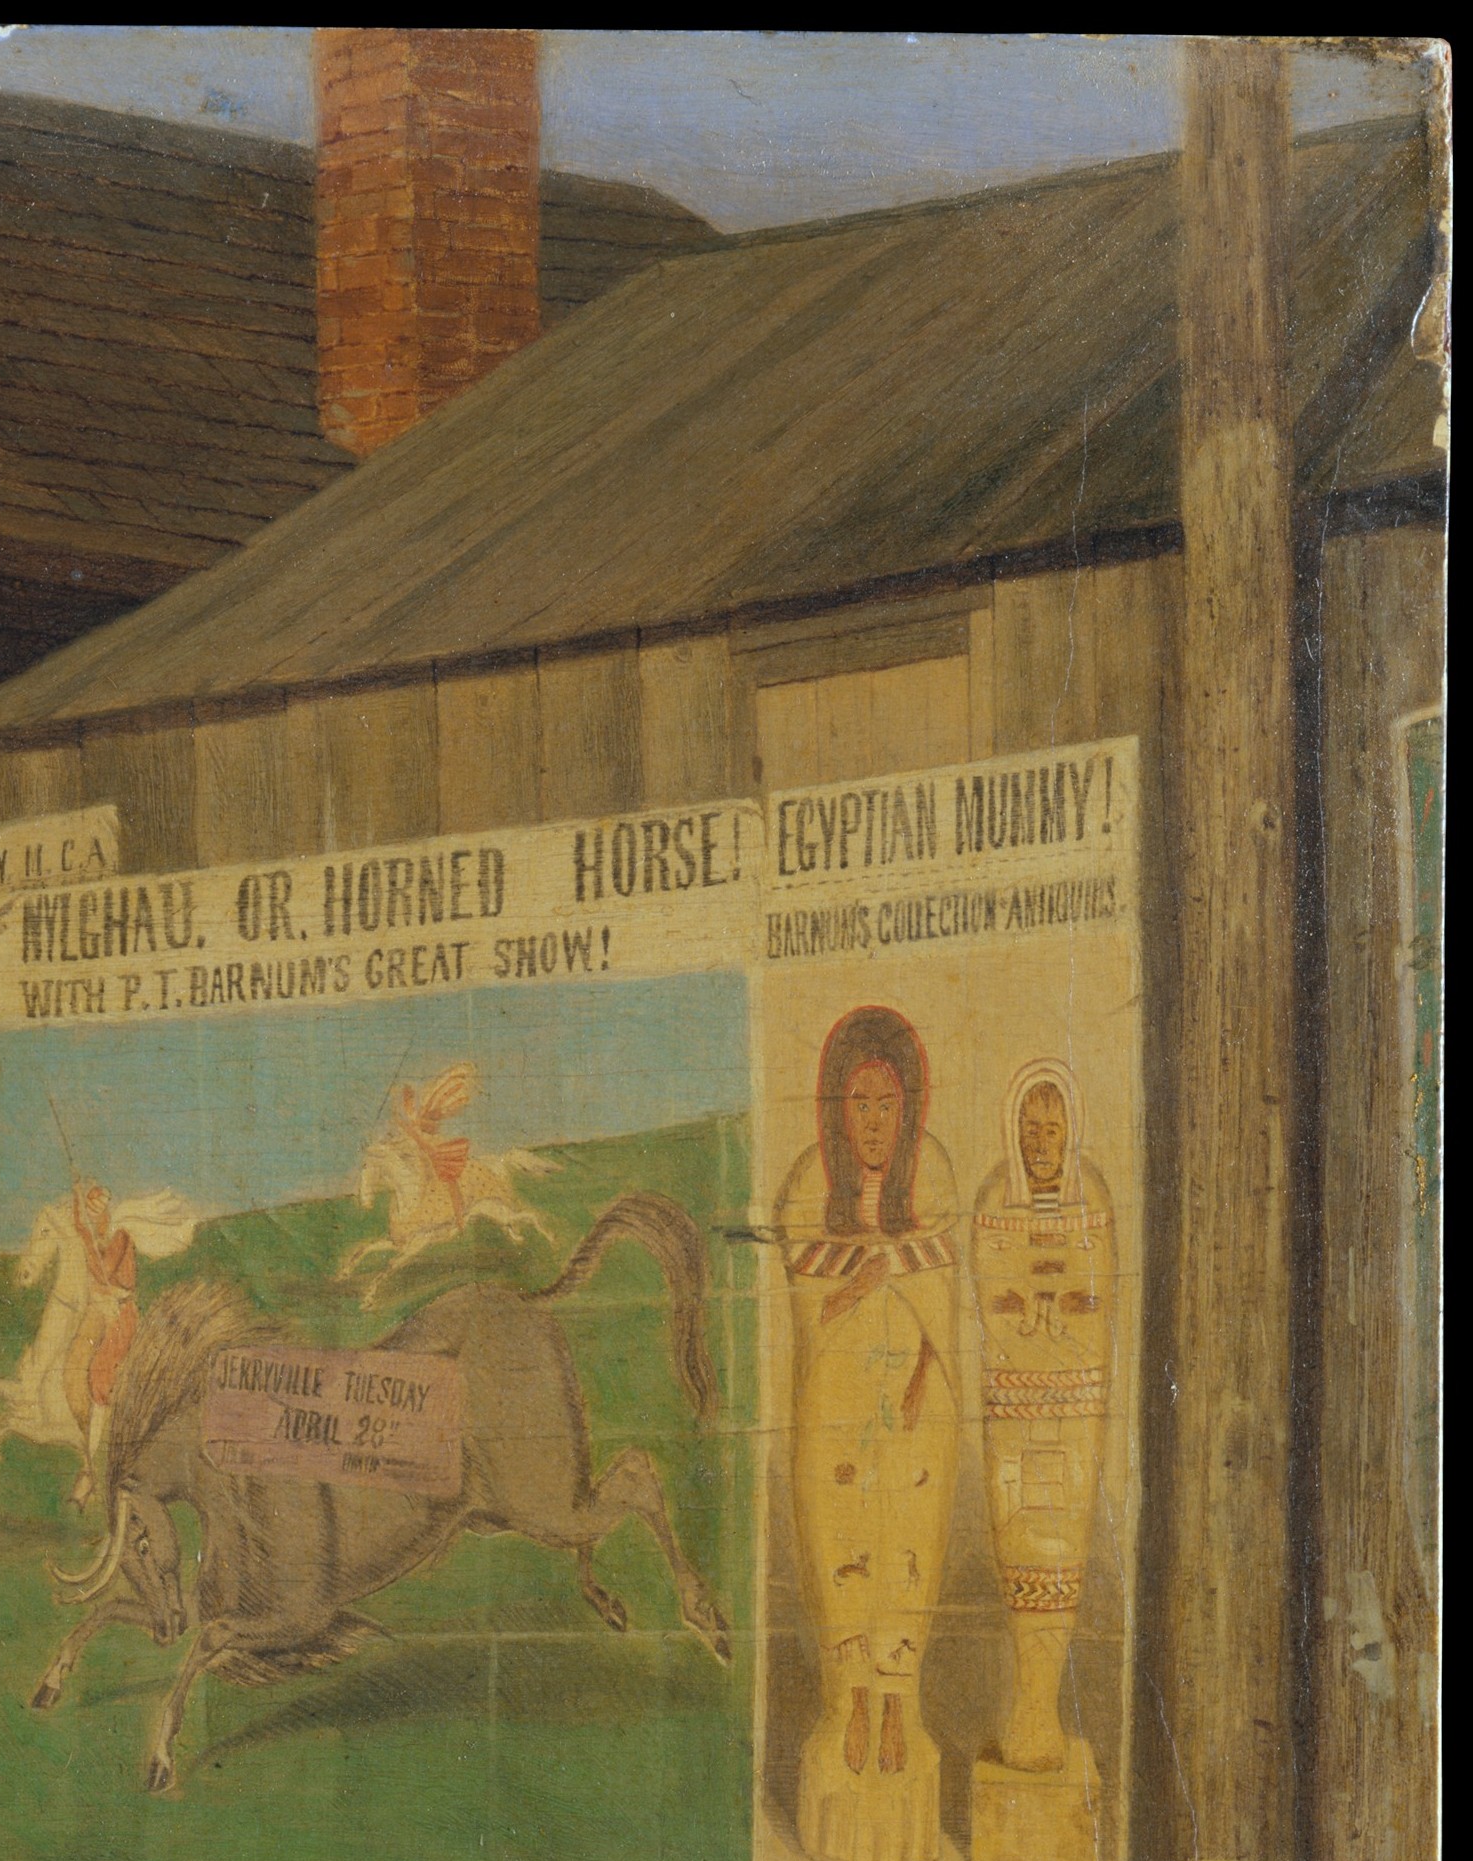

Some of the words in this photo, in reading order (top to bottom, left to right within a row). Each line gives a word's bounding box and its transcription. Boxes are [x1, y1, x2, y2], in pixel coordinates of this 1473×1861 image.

[324, 847, 505, 937] HORNED
[574, 812, 741, 904] HORSE!
[778, 781, 937, 876] EGYPTIAN
[18, 975, 106, 1019] WITH
[365, 941, 471, 990] GREAT
[494, 924, 612, 979] SHOW!
[272, 1404, 343, 1447] APRIL
[343, 1369, 432, 1414] TUESDAY
